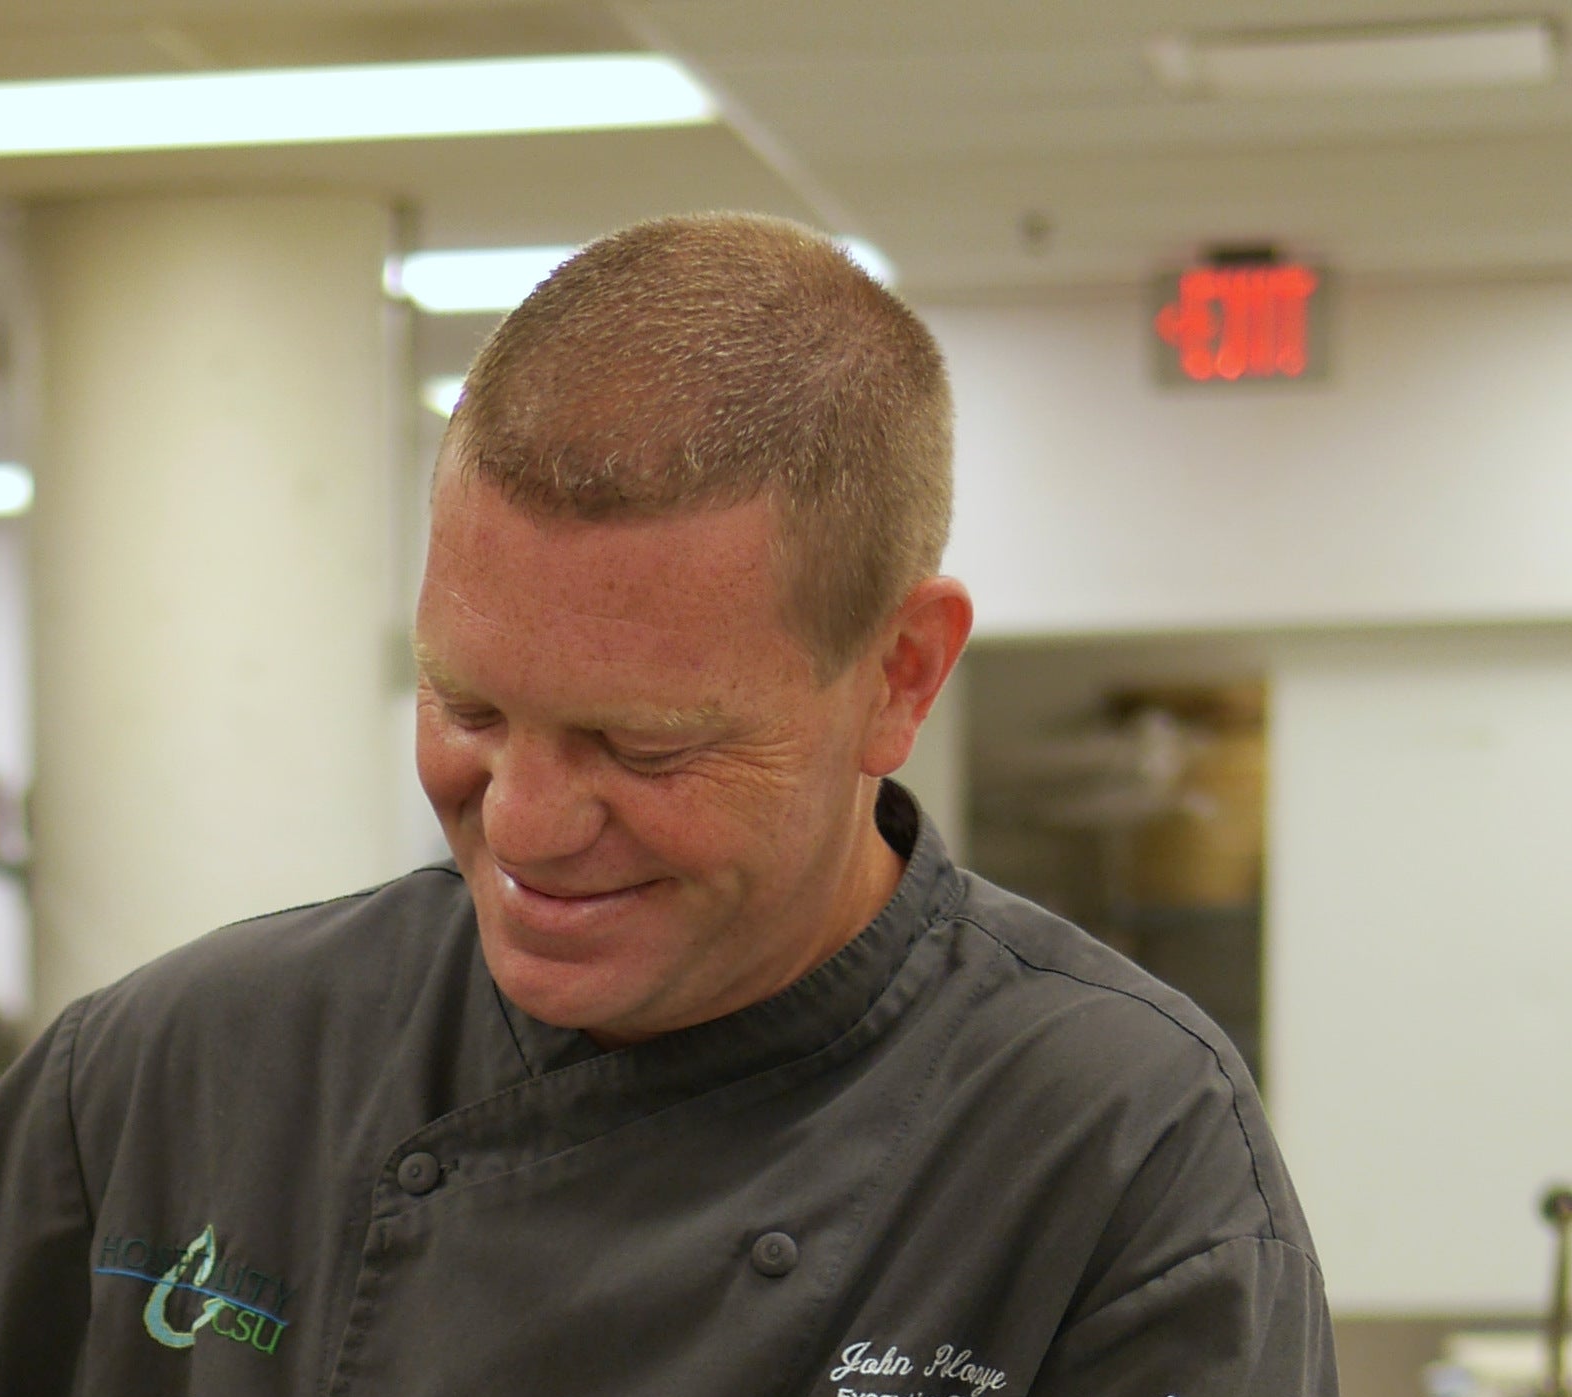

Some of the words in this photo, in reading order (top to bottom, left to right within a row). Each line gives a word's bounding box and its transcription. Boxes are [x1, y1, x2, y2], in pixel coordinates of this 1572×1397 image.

[1179, 268, 1318, 382] EXIT
[210, 1302, 286, 1355] CSU
[829, 1340, 913, 1382] John
